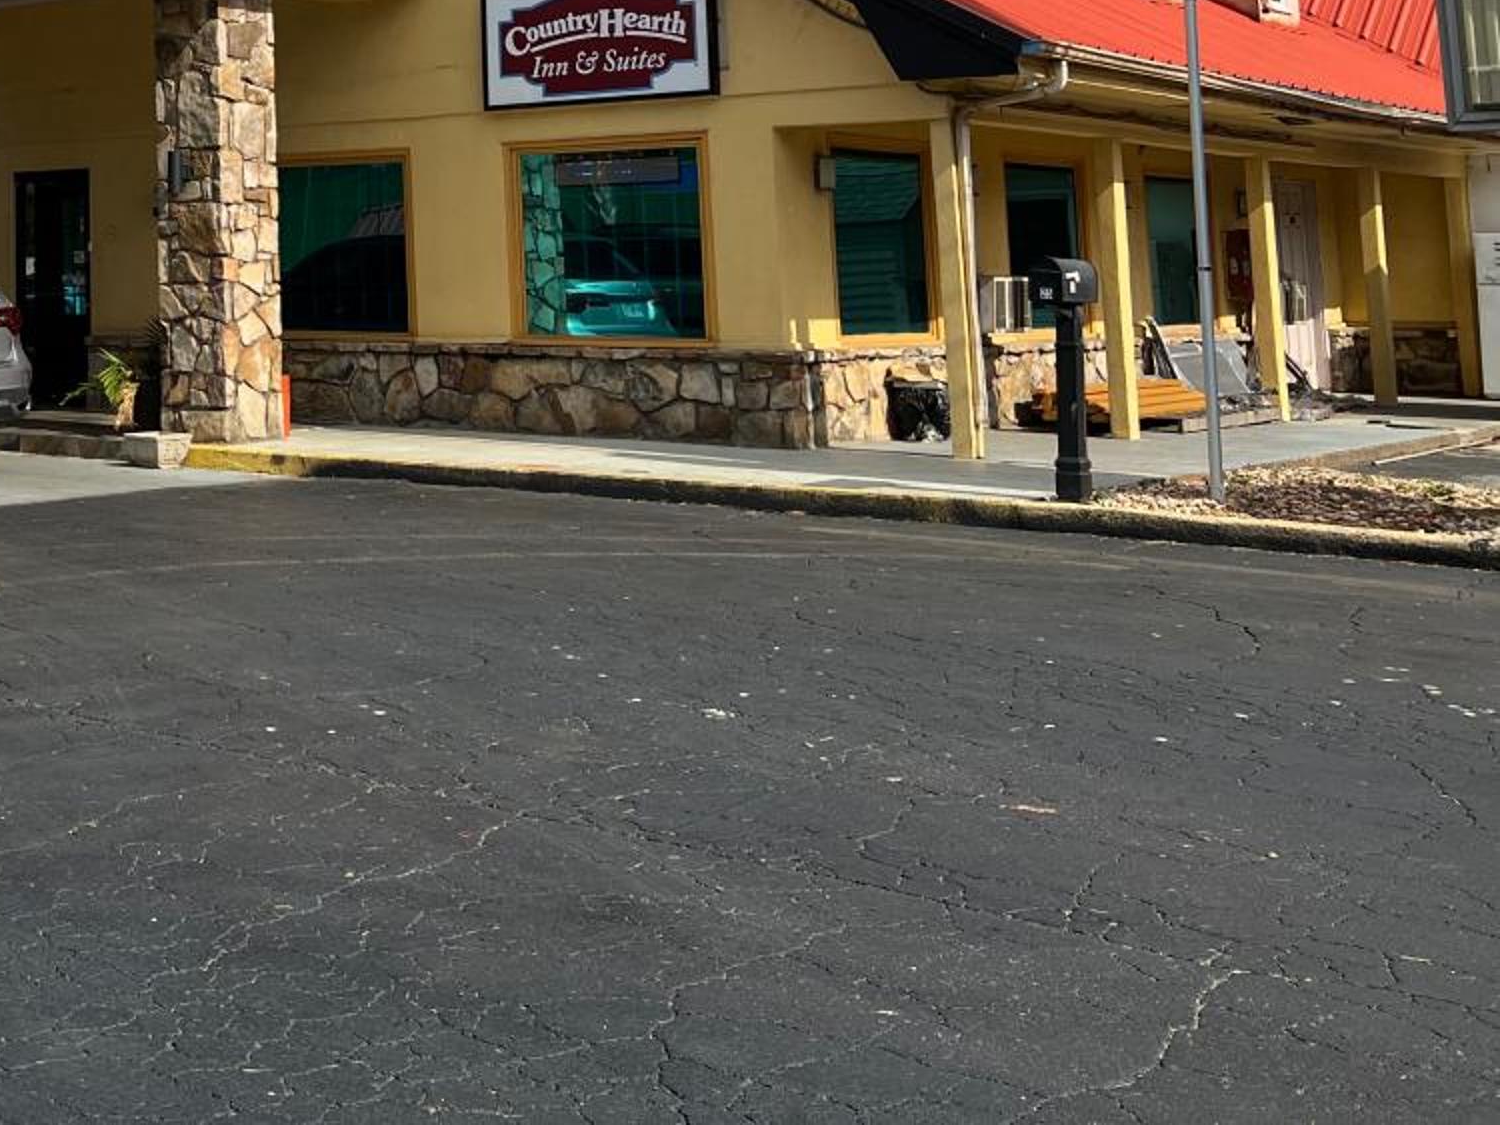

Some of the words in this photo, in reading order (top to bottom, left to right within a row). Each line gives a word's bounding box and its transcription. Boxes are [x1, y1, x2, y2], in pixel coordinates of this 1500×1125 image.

[532, 56, 569, 79] Inn
[575, 50, 599, 74] &
[603, 46, 667, 73] Suites
